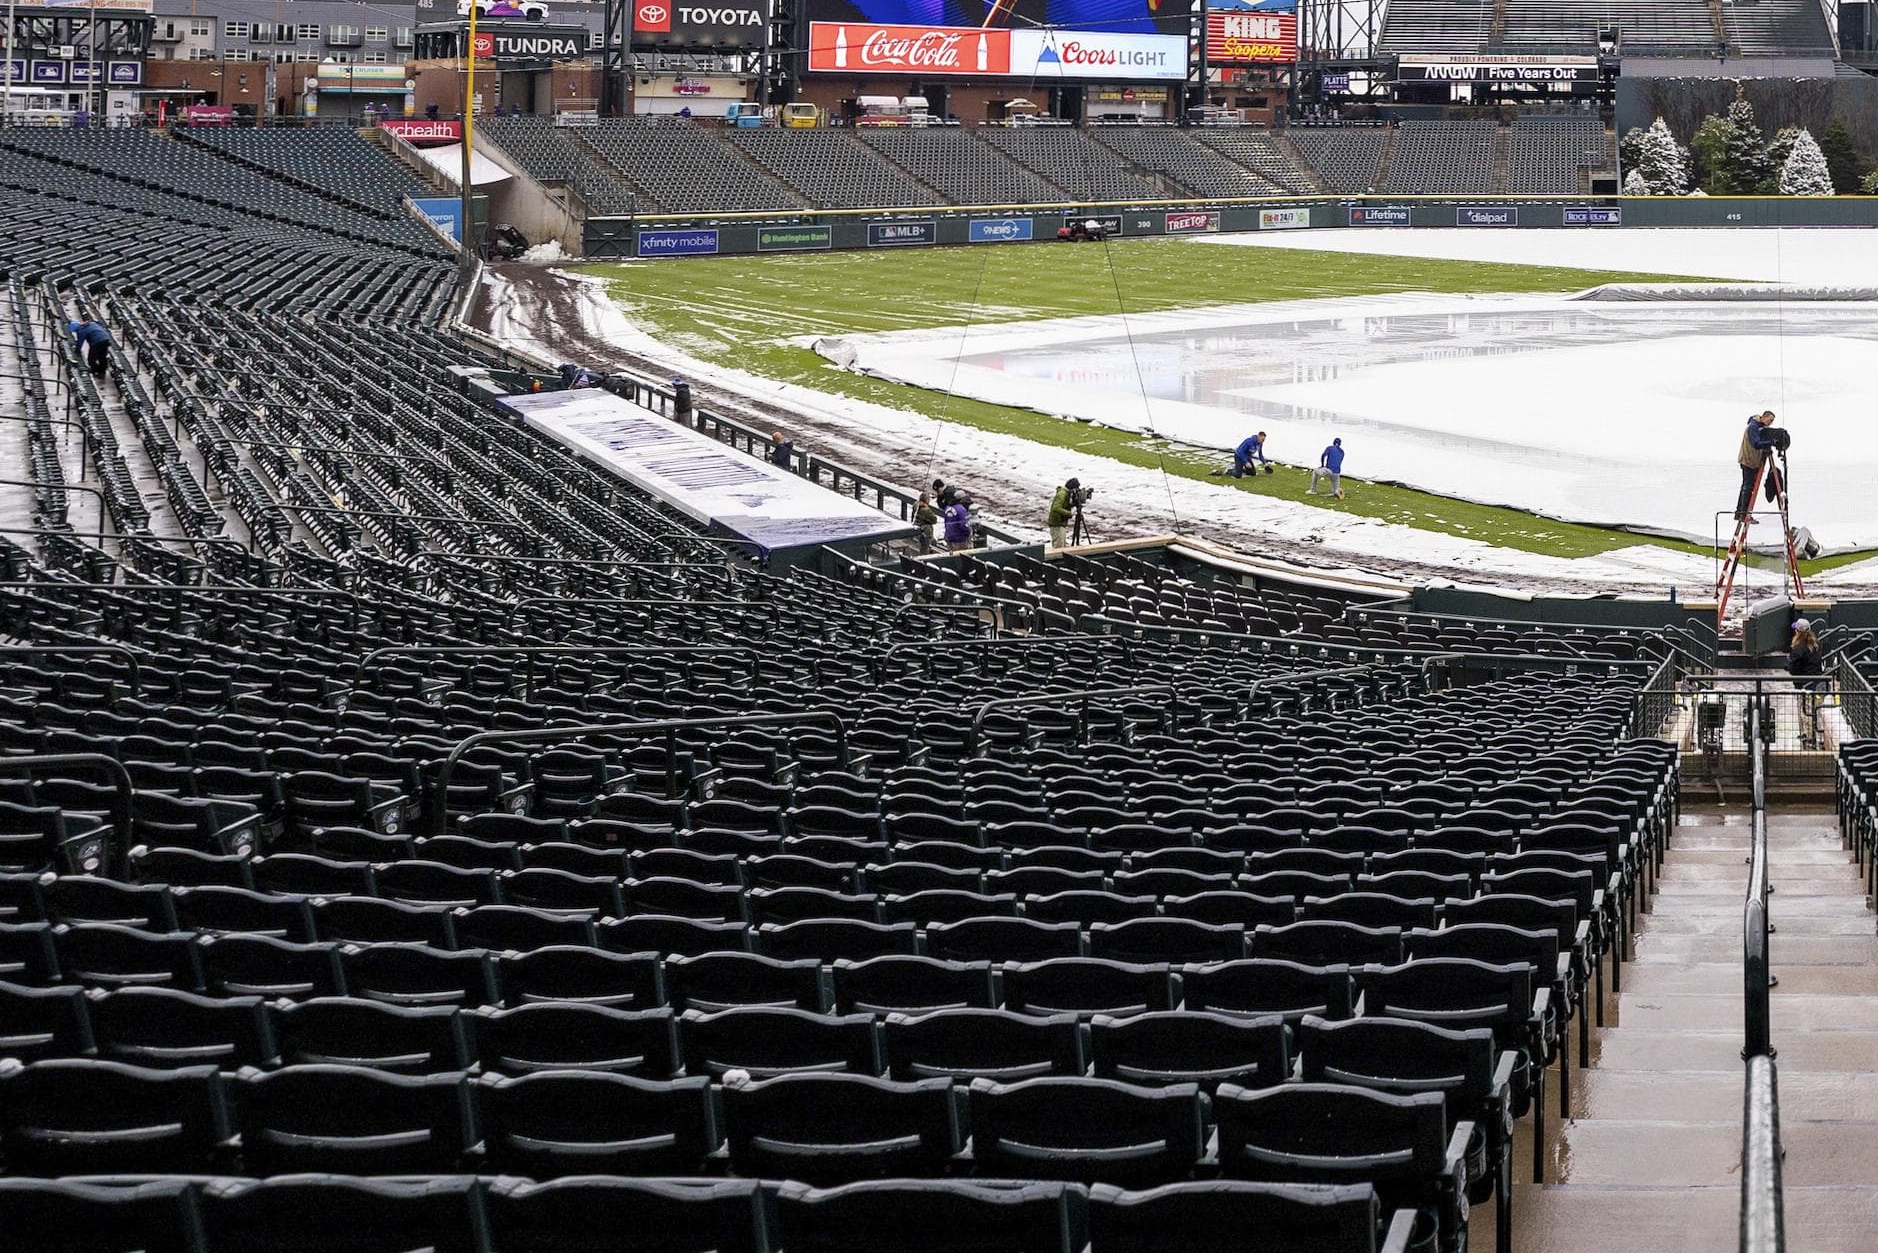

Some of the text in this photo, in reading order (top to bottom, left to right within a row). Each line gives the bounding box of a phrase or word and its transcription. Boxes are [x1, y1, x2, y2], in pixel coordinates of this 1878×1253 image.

[418, 0, 434, 9] 485
[678, 7, 763, 26] TOYOTA
[1224, 16, 1281, 39] KING
[496, 37, 578, 55] TUNDRA
[861, 30, 961, 67] Coca-Cola
[1223, 37, 1281, 60] Soopers
[1062, 42, 1166, 67] Coors LIGHT
[1425, 66, 1577, 79] ARROW Five Years Out
[1324, 76, 1348, 85] PLATTE
[1263, 213, 1294, 223] Fix-it 24/7
[1365, 210, 1407, 221] Lifetime
[1471, 211, 1507, 225] dialpad
[772, 231, 829, 245] Huntington Bank
[897, 225, 926, 237] MLB+
[642, 234, 716, 250] xfinity mobile
